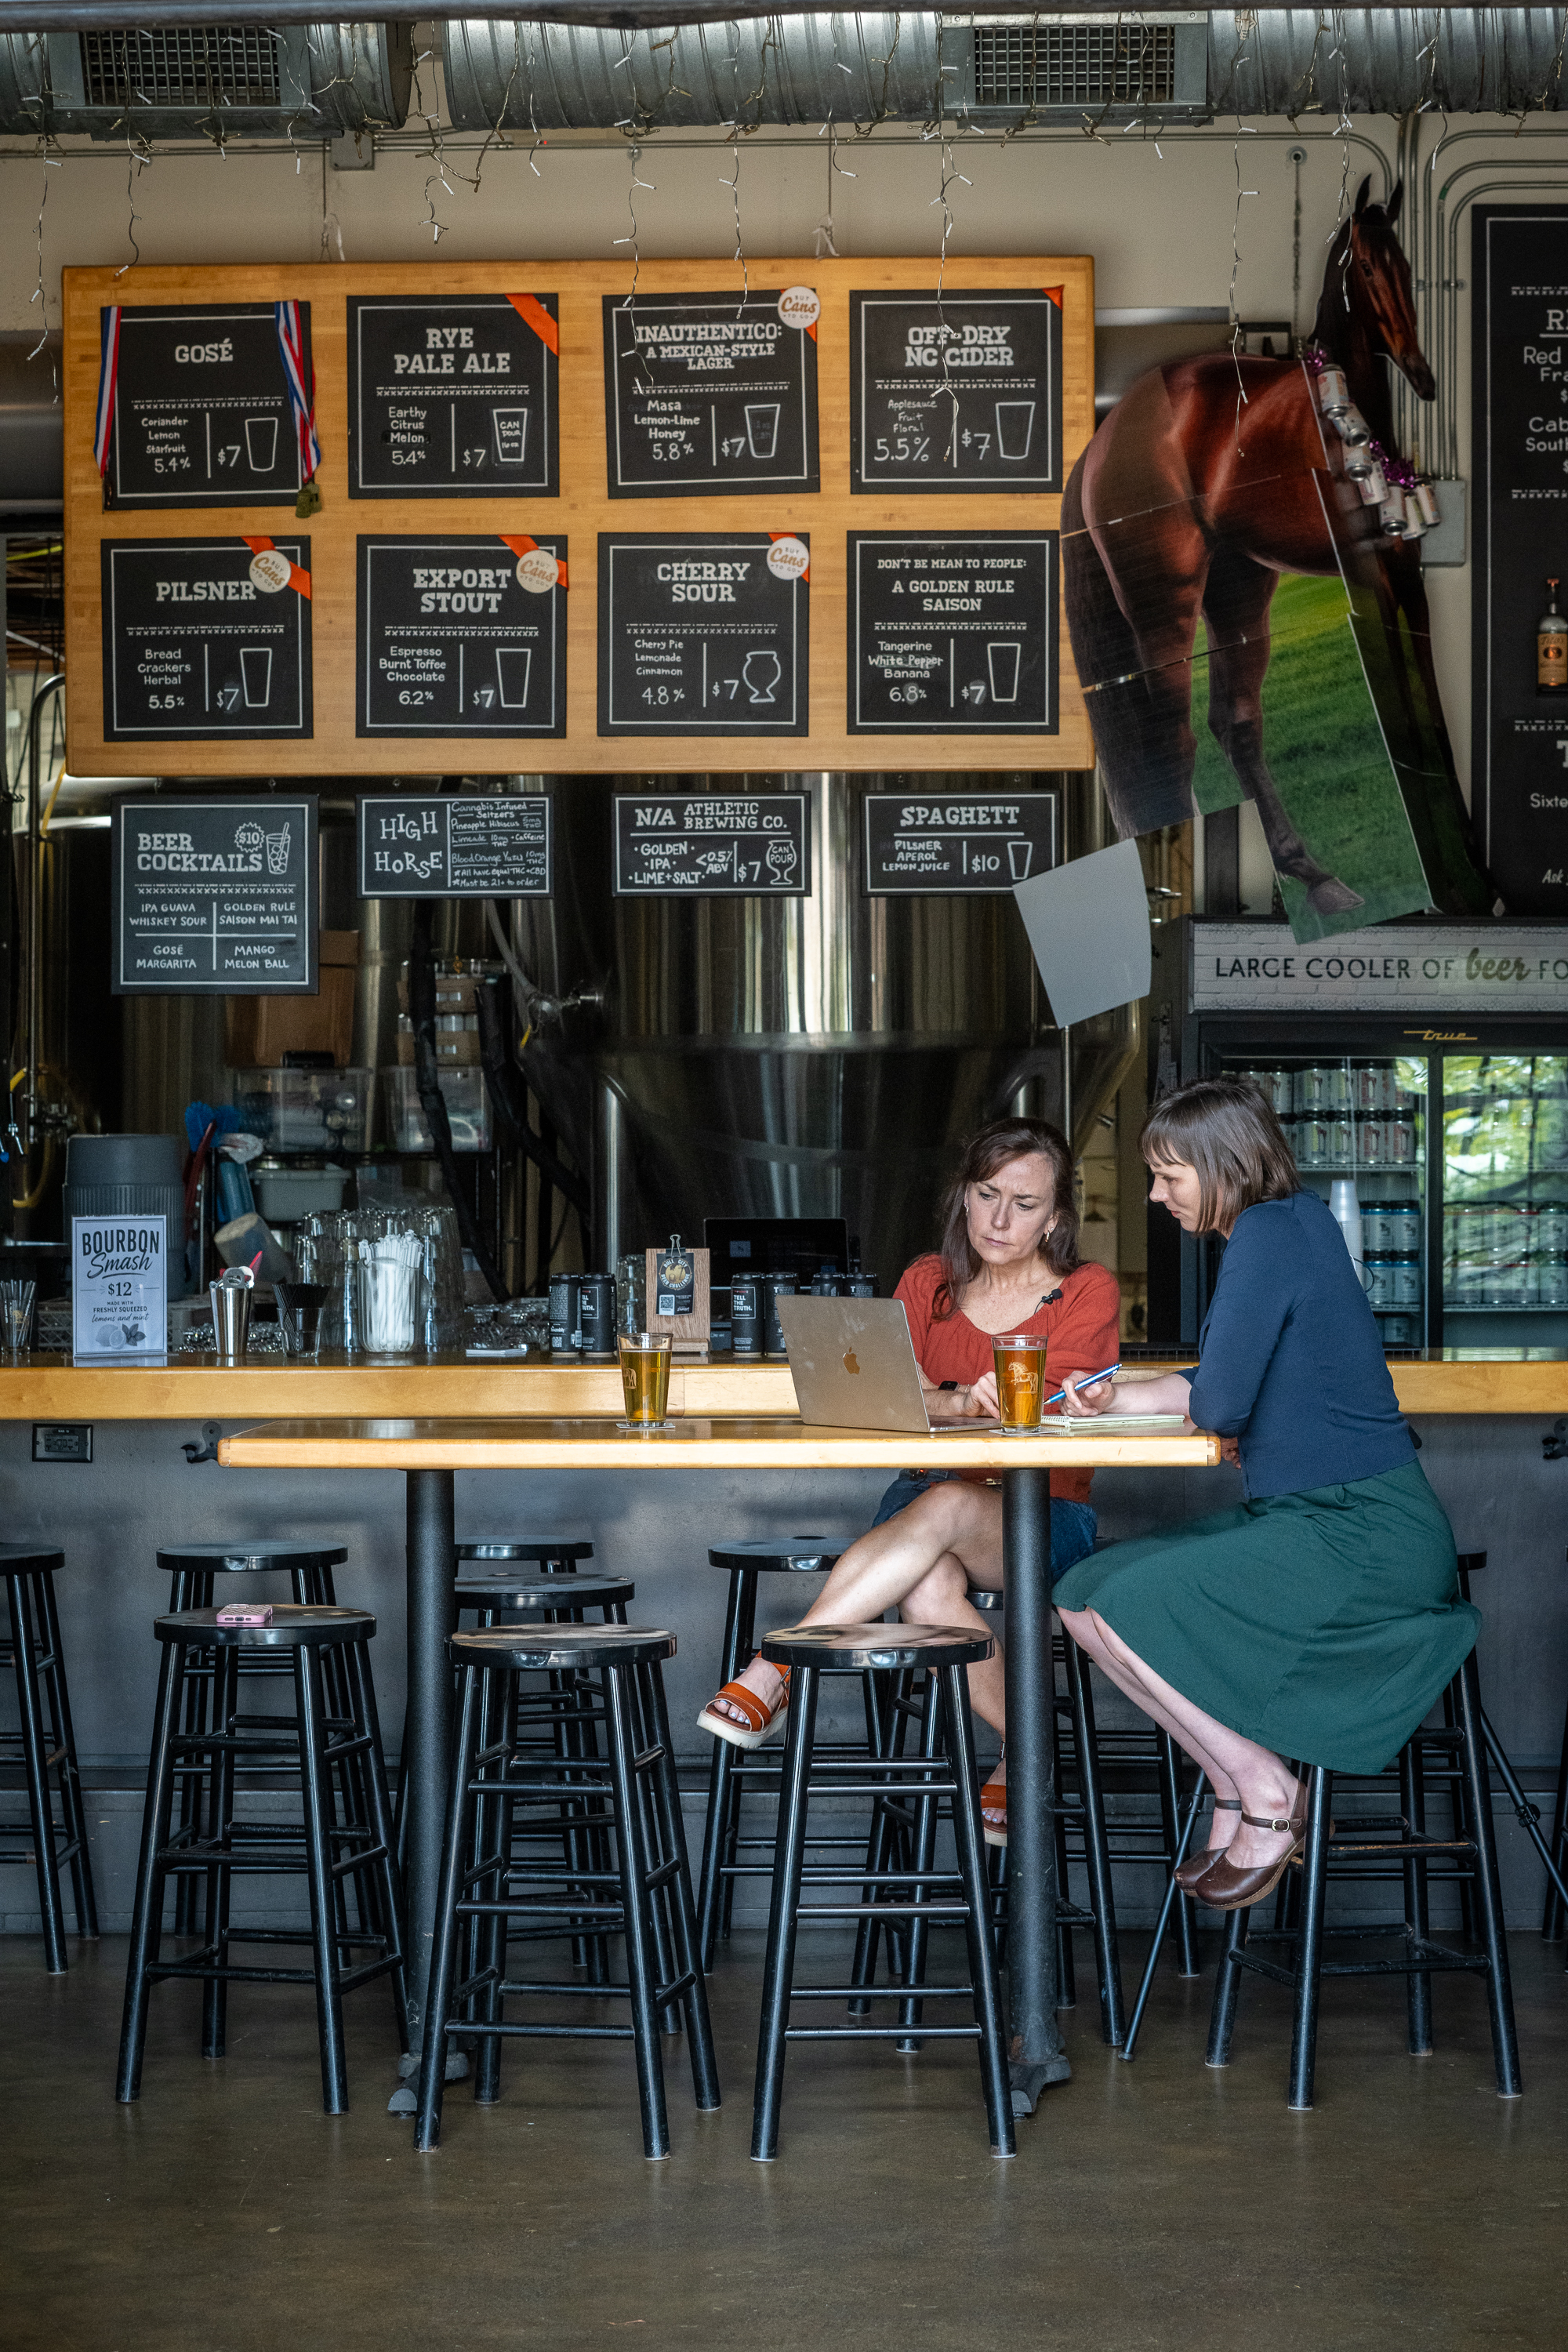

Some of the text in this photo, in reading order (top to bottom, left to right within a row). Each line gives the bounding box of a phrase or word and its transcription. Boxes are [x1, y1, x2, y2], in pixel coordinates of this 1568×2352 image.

[781, 296, 817, 314] Cans
[426, 328, 474, 349] RYE
[636, 322, 782, 343] INAUTHENTICO:
[908, 325, 1011, 345] OFF-DRY
[175, 338, 233, 363] GOSÉ
[645, 343, 775, 358] A MEXICAN-STYLE
[905, 346, 1014, 367] NC CIDER
[1523, 346, 1562, 365] Red
[394, 353, 510, 374] PALE ALE
[688, 358, 735, 371] LAGER
[647, 400, 681, 412] Masa
[887, 399, 938, 411] Applesauce
[388, 406, 427, 420] Earthy
[898, 412, 924, 422] Fruit
[141, 416, 188, 426] Coriander
[390, 420, 425, 430] Citrus
[499, 420, 520, 430] CAN
[634, 414, 700, 426] Lemon-Lime
[648, 427, 686, 441] Honey
[893, 423, 924, 433] Floral
[148, 430, 180, 440] Lemon
[390, 432, 425, 443] Melon
[146, 444, 187, 454] Starfruit
[721, 437, 746, 458] $7
[873, 437, 931, 462] 5.5%
[961, 428, 991, 460] $7
[218, 445, 241, 467] $7
[391, 450, 426, 465] 5.4%
[652, 442, 694, 462] 5.8%
[154, 457, 191, 474] 5.4%
[770, 547, 806, 568] Cans
[877, 558, 1027, 569] DON'T BE MEAN TO PEOPLE:
[254, 557, 285, 586] Cans
[520, 559, 555, 582] Cans
[657, 562, 750, 581] CHERRY
[412, 568, 511, 588] EXPORT
[156, 580, 256, 601] PILSNER
[672, 583, 736, 602] SOUR
[891, 580, 1014, 593] A GOLDEN RULE
[420, 592, 502, 613] STOUT
[923, 598, 982, 611] SAISON
[390, 645, 442, 657] Espresso
[634, 639, 684, 650] Cherry Pie
[877, 641, 932, 653] Tangerine
[145, 648, 181, 660] Bread
[635, 652, 681, 662] Lemonade
[137, 663, 191, 673] Crackers
[379, 658, 446, 670] Burnt Toffee
[868, 655, 944, 669] White Pepper
[387, 671, 445, 682] Chocolate
[636, 666, 683, 676] Cinnamon
[884, 668, 931, 678] Banana
[144, 674, 181, 684] Herbal
[216, 688, 239, 710] $7
[398, 690, 434, 706] 6.2%
[473, 689, 494, 708] $7
[641, 686, 685, 706] 4.8%
[889, 685, 927, 702] 6.8%
[961, 684, 985, 705] $7
[148, 695, 185, 709] 5.5%
[451, 801, 528, 812] Cannabis Infused
[684, 802, 759, 816] ATHLETIC
[635, 807, 677, 826] N/A
[684, 815, 787, 829] BREWING CO.
[900, 805, 1020, 826] SPAGHETT
[379, 811, 438, 841] HIGH
[451, 818, 487, 831] Pineapple
[137, 833, 194, 851] BEER
[238, 832, 260, 845] $10
[452, 834, 487, 844] Limeade
[515, 833, 546, 841] Caffeine
[641, 840, 688, 855] GOLDEN
[895, 840, 942, 851] PILSNER
[137, 853, 263, 872] COCKTAILS
[451, 853, 475, 864] Blood
[770, 854, 793, 864] POUR
[896, 851, 938, 862] APEROL
[650, 858, 671, 869] IPA
[706, 863, 729, 874] ABV
[882, 862, 950, 873] LEMON JUICE
[971, 855, 1000, 873] $10
[491, 867, 510, 877] equal
[739, 861, 761, 882] $7
[1541, 869, 1564, 884] Ask
[516, 877, 539, 886] order
[141, 903, 196, 913] IPA GUAVA
[223, 902, 296, 912] GOLDEN RULE
[129, 916, 207, 926] WHISKEY SOUR
[219, 914, 297, 925] SAISON MAI TAI
[153, 944, 183, 955] GOSÉ
[234, 946, 275, 956] MANGO
[136, 959, 197, 969] MARGARITA
[224, 959, 289, 969] MELON BALL
[1215, 946, 1532, 982] LARGE COOLER OF beer
[82, 1229, 160, 1256] BOURBON
[87, 1247, 153, 1279] Smash
[662, 1258, 688, 1269] BULL CITY
[107, 1282, 132, 1297] $12
[92, 1312, 149, 1323] lemons and mint
